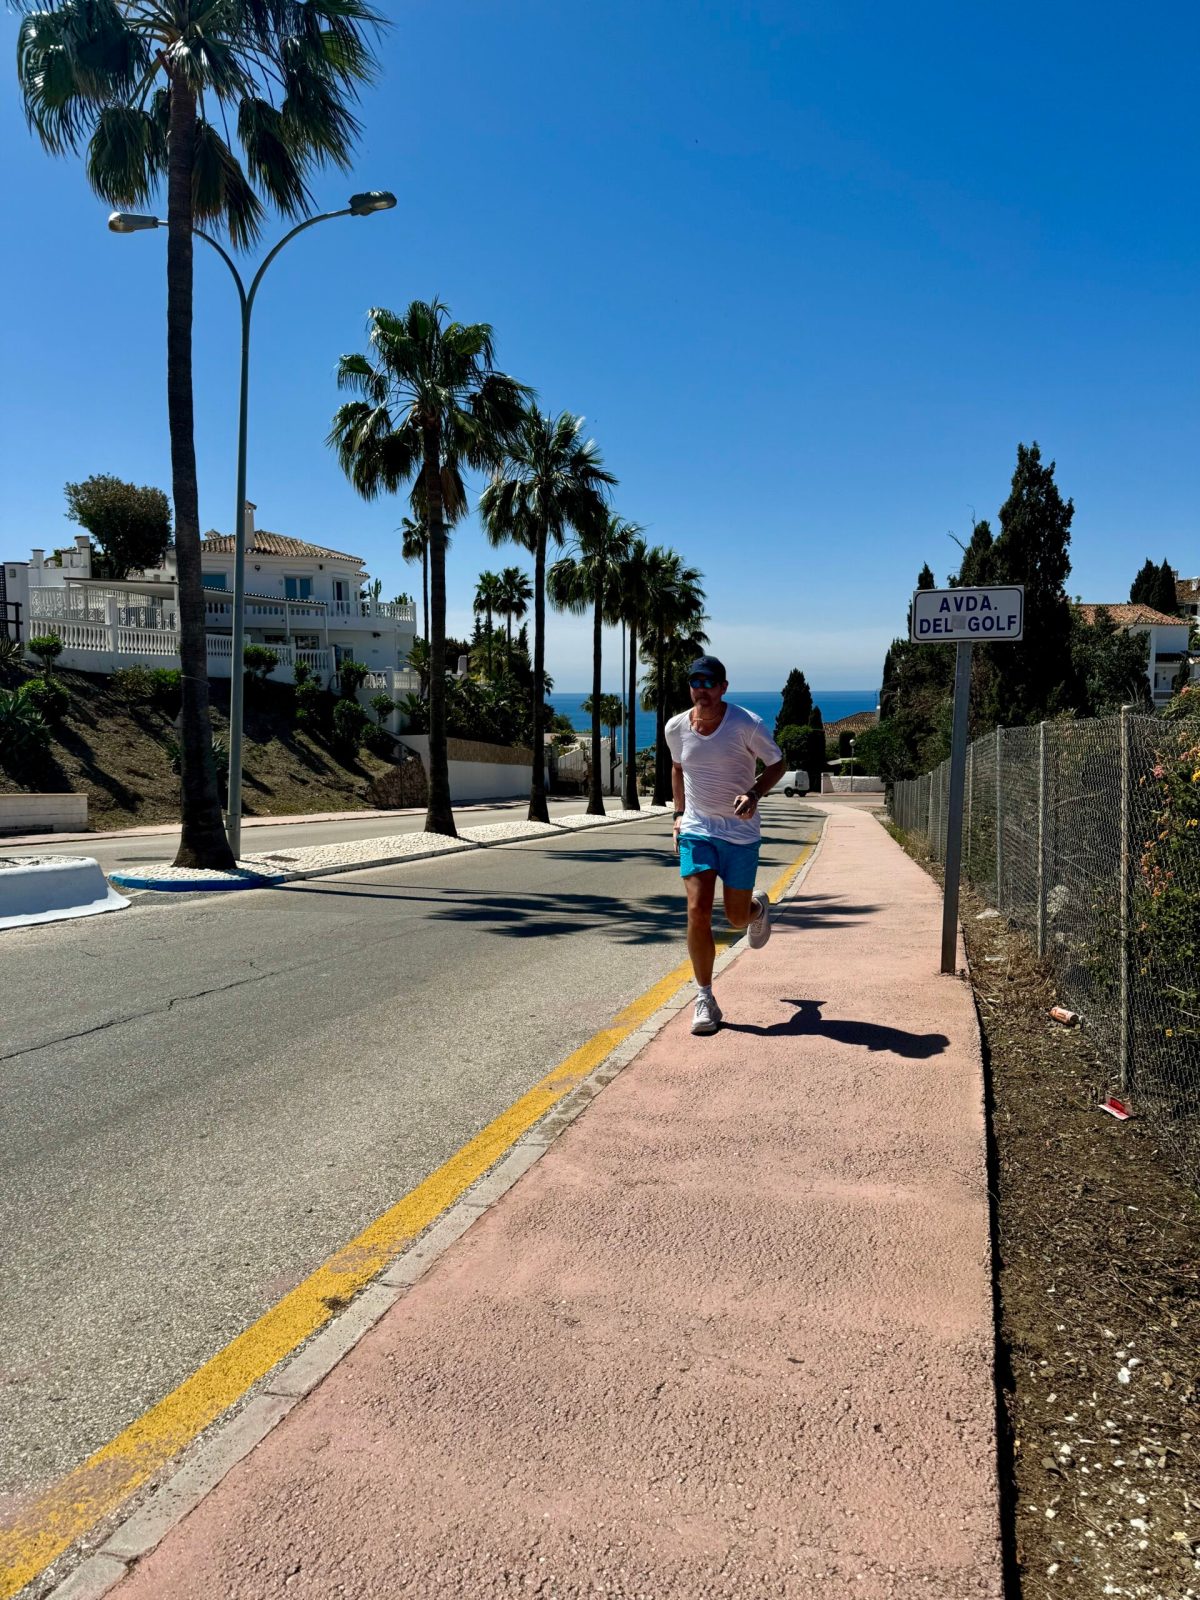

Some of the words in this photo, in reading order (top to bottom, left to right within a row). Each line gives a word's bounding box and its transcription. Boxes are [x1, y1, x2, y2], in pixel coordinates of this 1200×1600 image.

[939, 595, 998, 613] AVDA.
[919, 618, 953, 634] DEL
[967, 615, 1017, 632] GOLF
